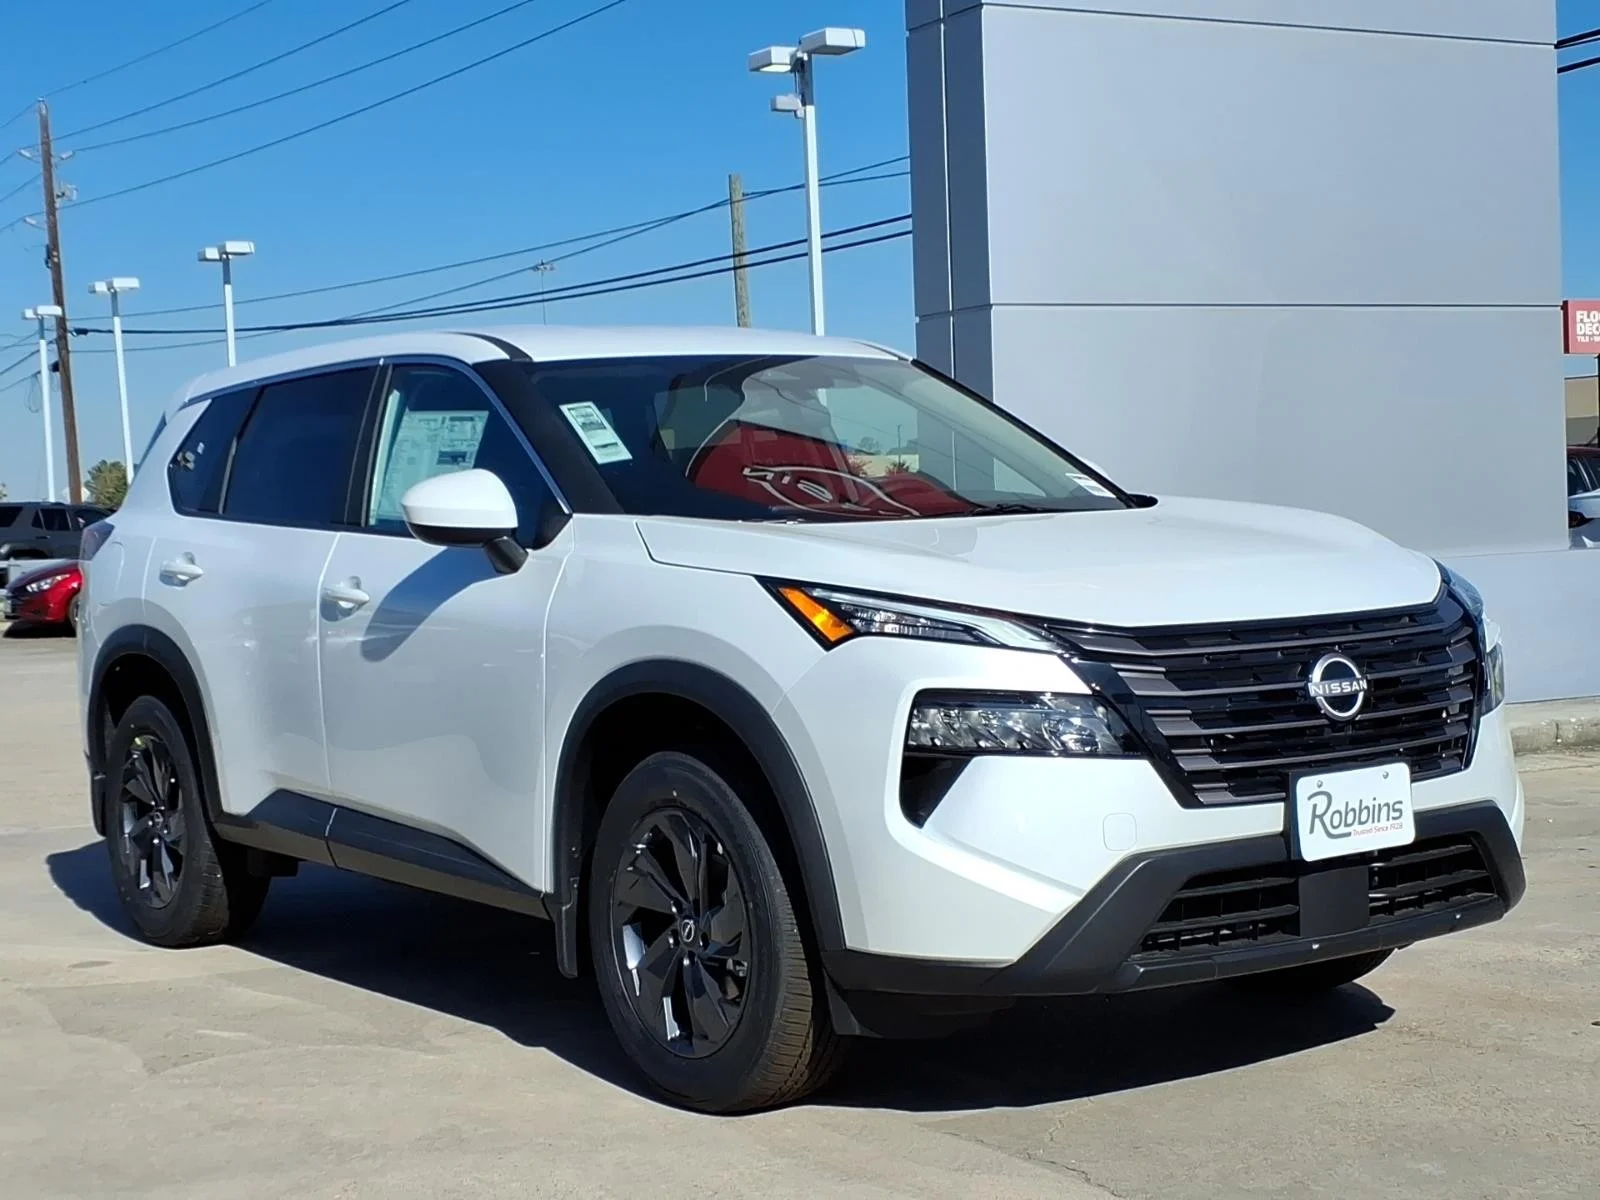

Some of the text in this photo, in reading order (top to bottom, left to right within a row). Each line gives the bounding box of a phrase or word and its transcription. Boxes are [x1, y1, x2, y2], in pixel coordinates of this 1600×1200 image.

[1576, 310, 1600, 323] FLO
[1308, 679, 1367, 696] NISSAN
[1307, 790, 1403, 839] Robbins
